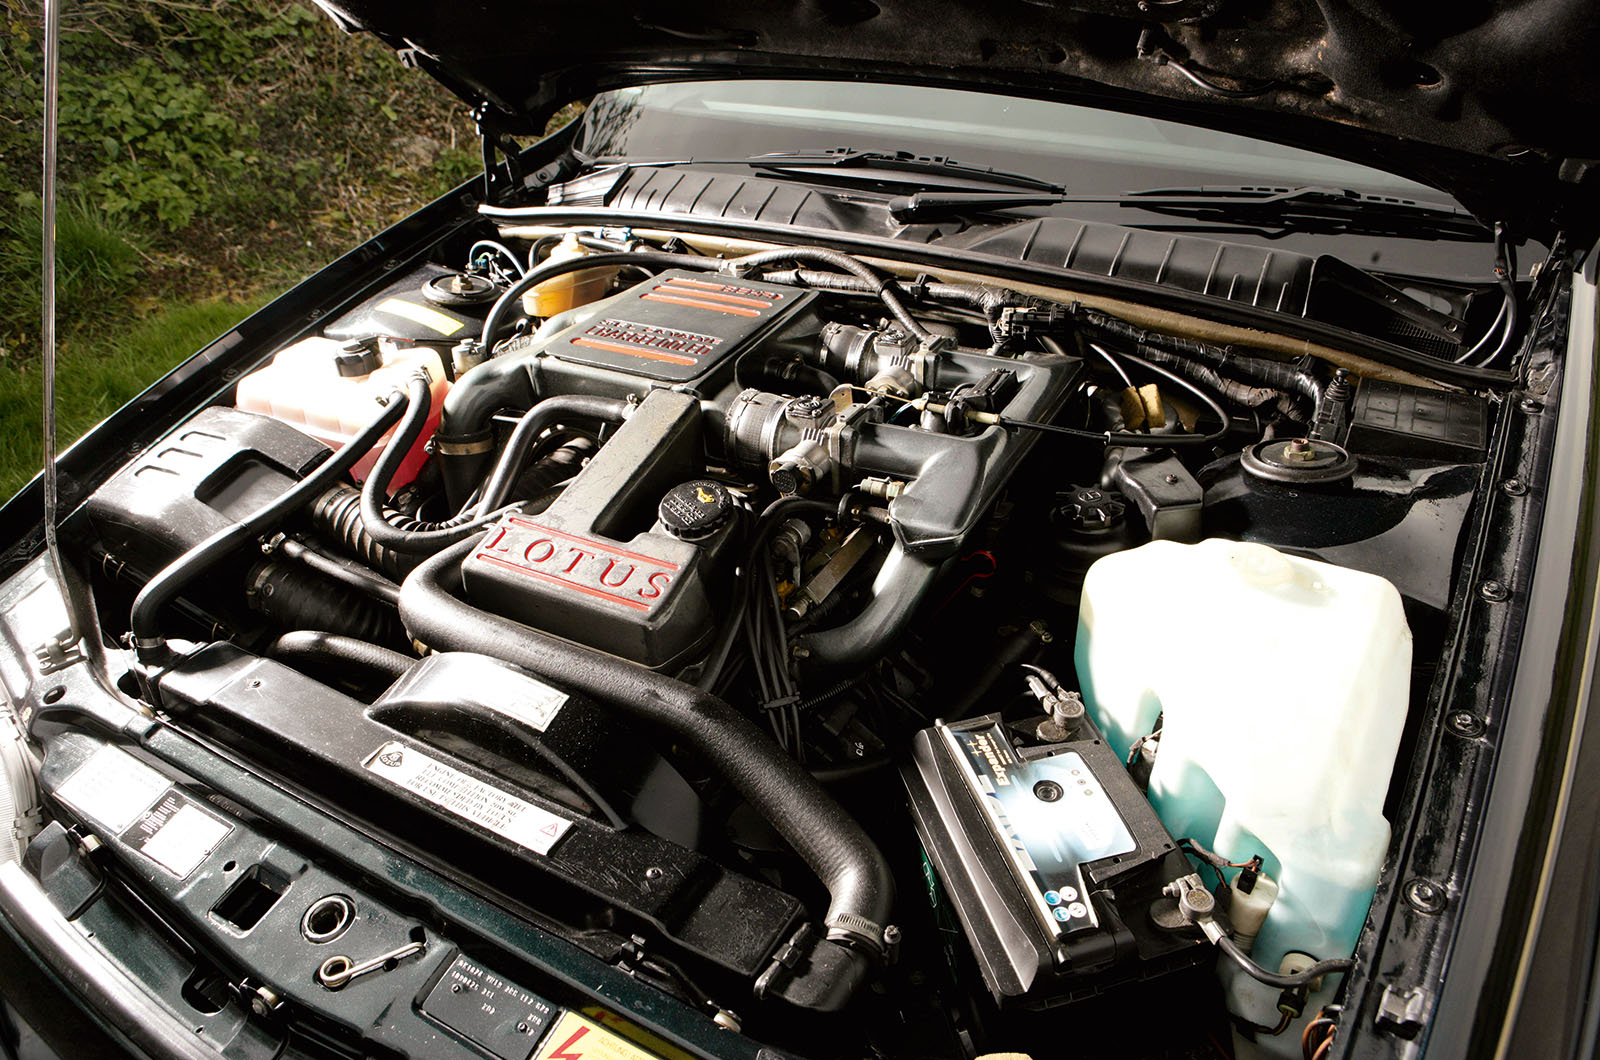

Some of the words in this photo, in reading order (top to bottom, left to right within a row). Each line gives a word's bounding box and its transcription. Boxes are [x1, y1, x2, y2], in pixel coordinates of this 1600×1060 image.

[585, 325, 713, 355] CHARGECOOLED
[485, 526, 673, 599] LOTUS
[974, 734, 1011, 786] Expander
